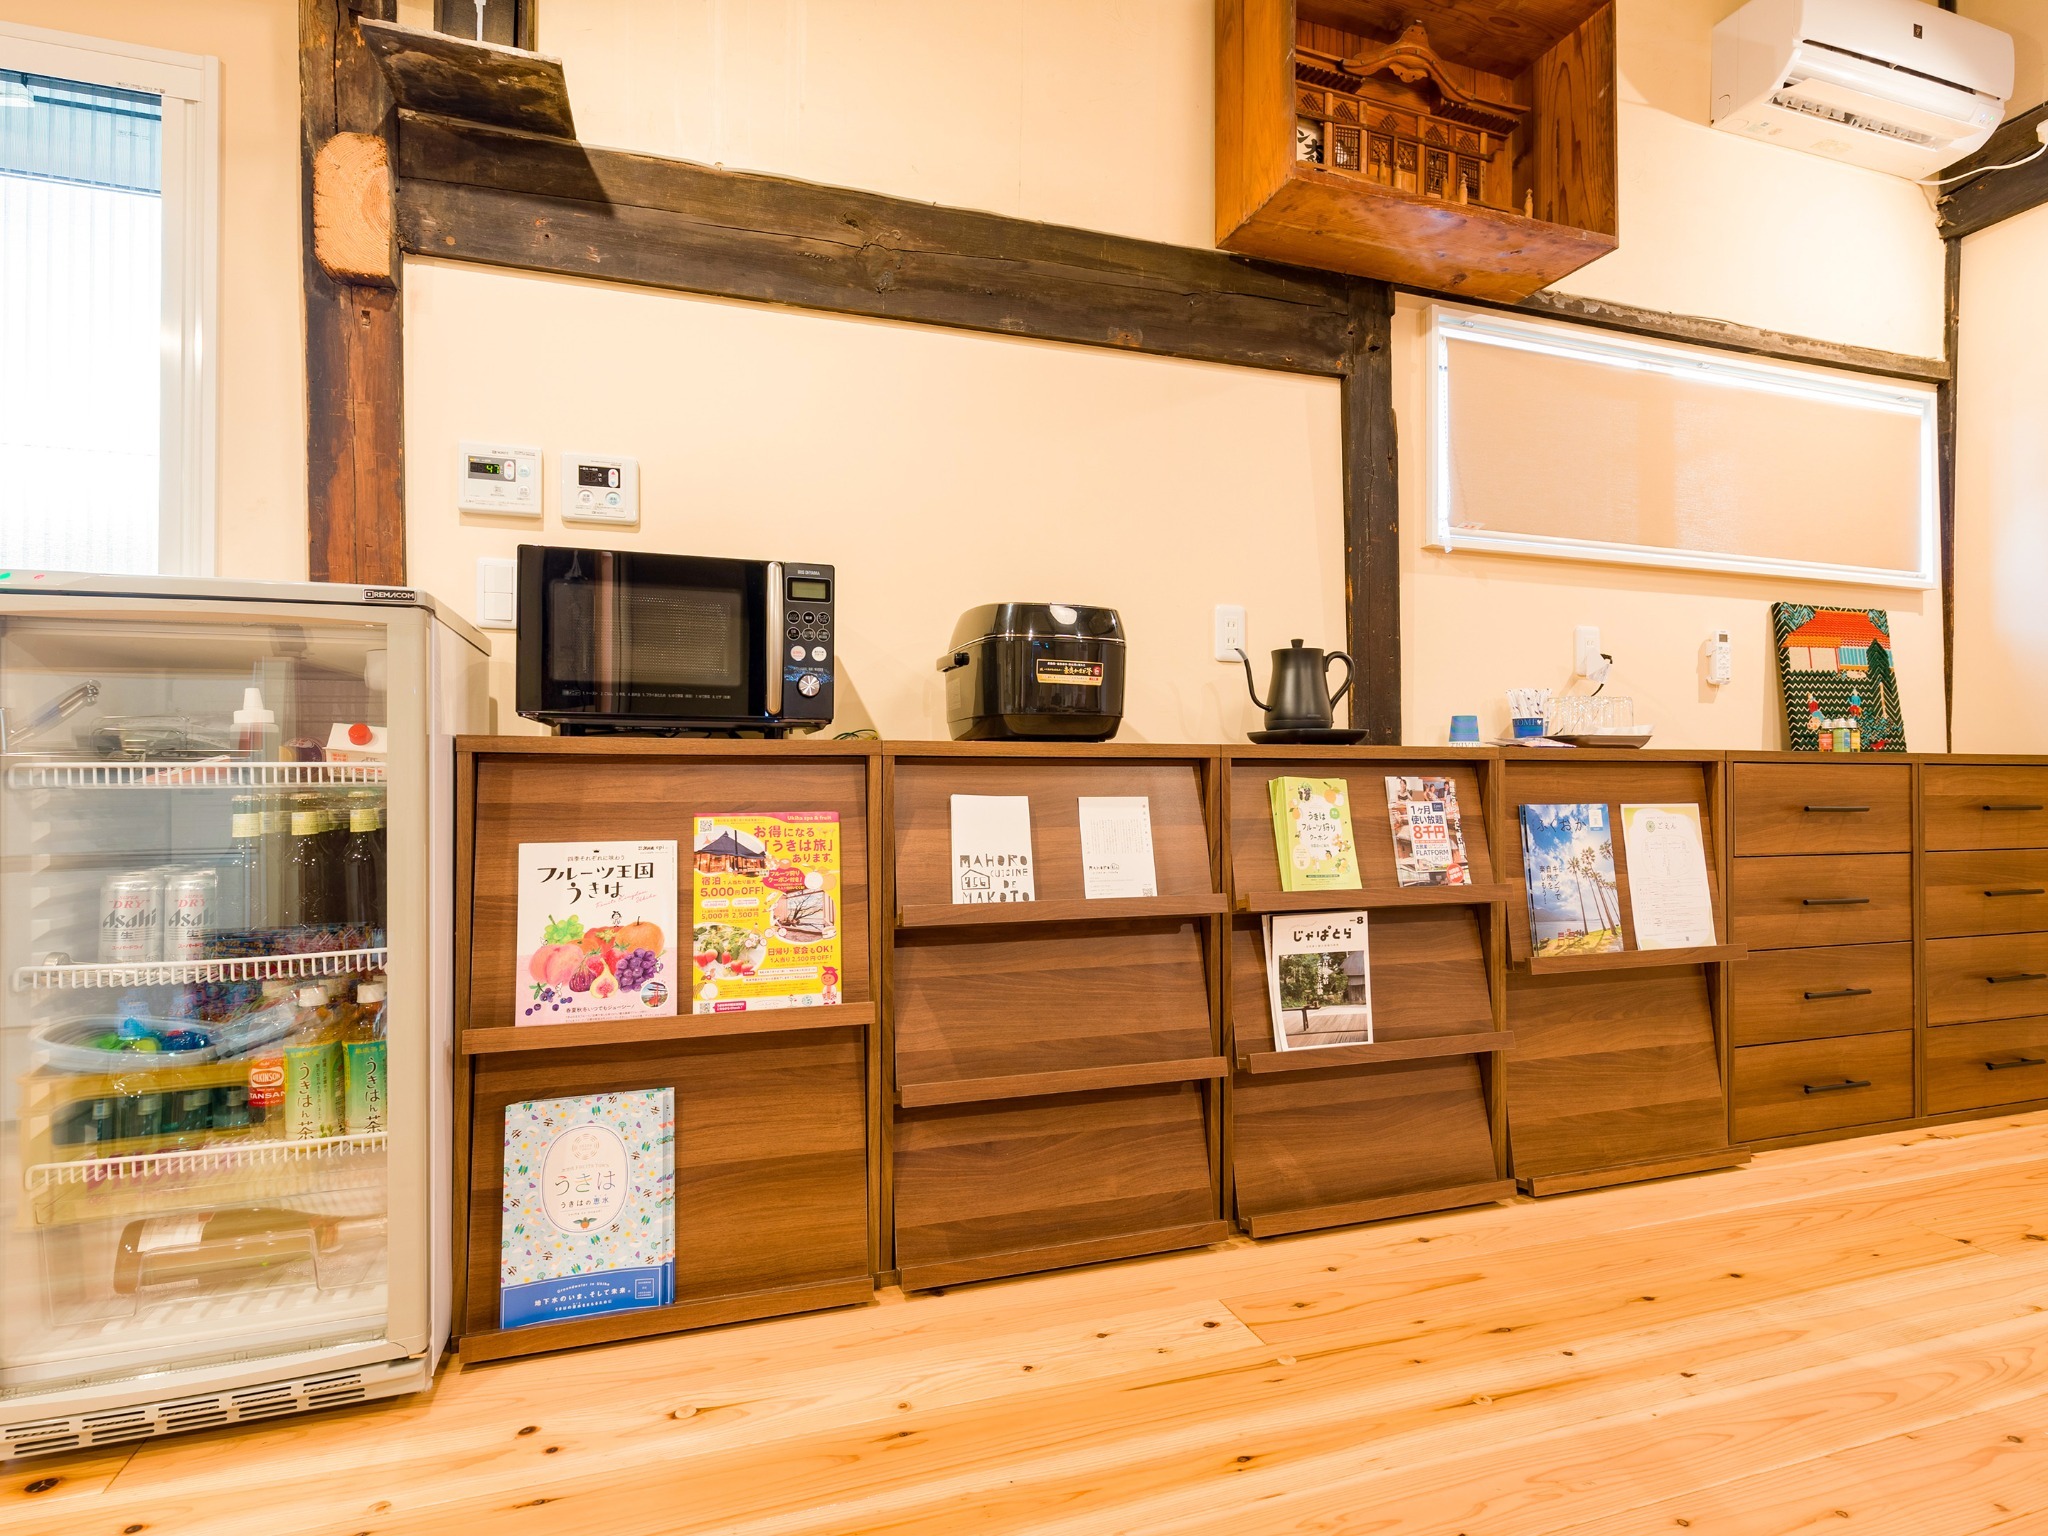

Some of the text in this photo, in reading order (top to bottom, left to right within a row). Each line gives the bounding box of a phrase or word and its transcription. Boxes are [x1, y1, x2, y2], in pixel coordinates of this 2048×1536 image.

[374, 591, 414, 599] REMACOM
[1308, 811, 1326, 821] うきは
[1411, 815, 1444, 825] 使い放題
[753, 825, 815, 838] お得になる
[1301, 823, 1336, 832] フルーツ狩り
[1413, 825, 1446, 840] 8千円
[1537, 818, 1587, 833] ふくおか
[792, 853, 833, 864] あります。
[959, 853, 1028, 869] MAHORO
[537, 862, 654, 884] フルーツ王国
[990, 868, 1029, 878] CUISINE
[701, 876, 721, 886] 宿泊
[1003, 880, 1017, 889] DE
[566, 881, 623, 905] うきは
[700, 887, 741, 898] 5,000円
[962, 889, 1030, 905] MAKOTO
[102, 908, 157, 929] Asahi
[1293, 925, 1352, 942] じゃぱとら
[297, 1062, 315, 1141] うきはん茶
[364, 1057, 384, 1134] うきはん茶
[555, 1170, 616, 1197] うきは
